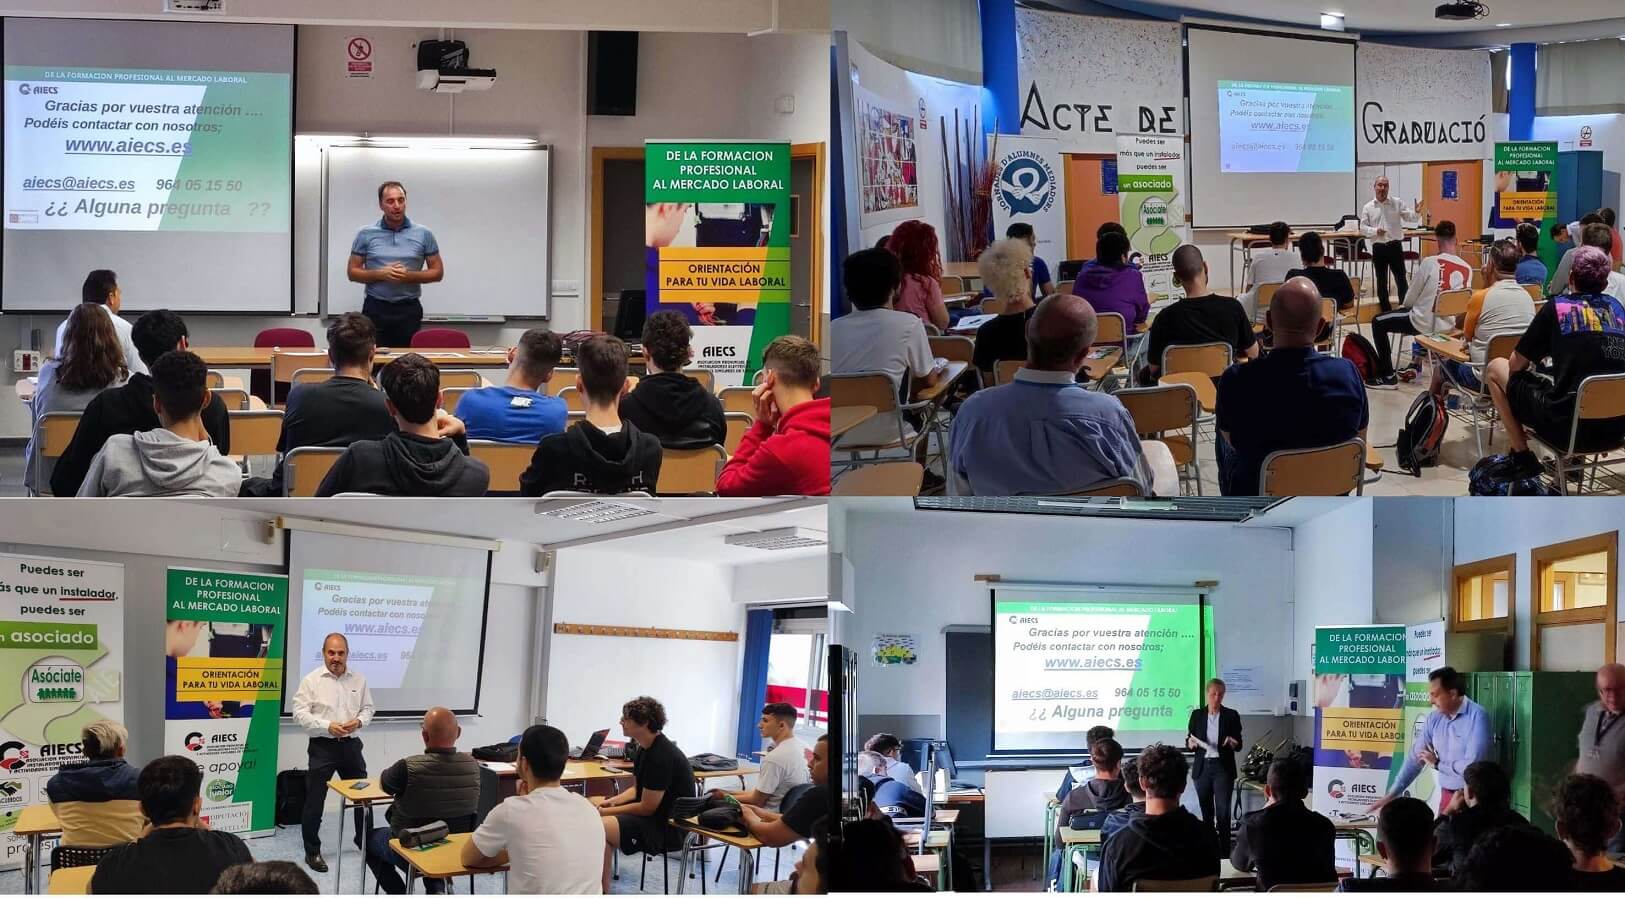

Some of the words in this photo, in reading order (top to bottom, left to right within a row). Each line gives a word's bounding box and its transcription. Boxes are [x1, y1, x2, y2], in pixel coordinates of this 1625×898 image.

[56, 71, 66, 79] LA
[67, 72, 112, 80] FORMACION
[114, 73, 164, 81] PROFESIONAL
[33, 86, 58, 95] AIECS
[45, 100, 98, 112] Gracias
[101, 103, 125, 115] por
[129, 103, 180, 115] vuestra
[183, 104, 241, 116] atención
[24, 117, 69, 129] Podéis
[72, 119, 132, 130] contactar
[135, 121, 159, 131] con
[162, 122, 223, 135] nosotros;
[65, 137, 193, 155] www.aiecs.es
[666, 151, 680, 160] DE
[684, 151, 698, 160] LA
[701, 151, 773, 161] FORMACION
[680, 165, 757, 175] PROFESIONAL
[23, 175, 135, 192] aiecs@aiecs.es
[156, 179, 181, 190] 964
[185, 179, 202, 191] 05
[205, 179, 222, 191] 15
[225, 180, 243, 192] 50
[653, 179, 667, 189] AL
[670, 179, 729, 190] MERCADO
[732, 179, 784, 190] LABORAL
[1132, 179, 1172, 189] asociado
[74, 198, 142, 218] Alguna
[147, 202, 232, 219] pregunta
[248, 202, 271, 217] ??
[1148, 254, 1169, 262] AIECS
[688, 262, 760, 274] ORIENTACIÓN
[666, 277, 693, 287] PARA
[697, 277, 708, 287] TU
[711, 277, 737, 287] VIDA
[740, 277, 786, 287] LABORAL
[702, 346, 736, 358] AIECS
[20, 563, 64, 576] Puedes
[67, 569, 85, 577] ser
[185, 577, 198, 586] DE
[200, 578, 213, 587] LA
[215, 579, 275, 591] FORMACION
[14, 585, 39, 597] que
[42, 586, 57, 595] un
[60, 587, 119, 600] instalador,
[197, 590, 261, 602] PROFESIONAL
[331, 594, 367, 604] Gracias
[368, 597, 385, 606] por
[386, 597, 418, 607] vuestra
[20, 605, 65, 616] puedes
[68, 607, 85, 616] ser
[173, 601, 186, 609] AL
[187, 602, 238, 612] MERCADO
[240, 604, 281, 614] LABORAL
[318, 607, 348, 617] Podéis
[349, 608, 387, 618] contactar
[389, 610, 405, 619] con
[10, 630, 94, 644] asociado
[1028, 628, 1070, 638] Gracias
[1072, 630, 1090, 639] por
[1093, 629, 1131, 638] vuestra
[1134, 629, 1178, 639] atención
[1013, 641, 1047, 651] Podéis
[1049, 642, 1095, 651] contactar
[1097, 643, 1116, 651] con
[1118, 643, 1165, 653] nosotros;
[1339, 644, 1396, 653] PROFESIONAL
[1044, 655, 1143, 671] www.aiecs.es
[1319, 656, 1330, 664] AL
[1331, 656, 1375, 664] MERCADO
[31, 667, 82, 683] Asóciate
[202, 669, 260, 679] ORIENTACIÓN
[1011, 688, 1098, 700] aiecs@aiecs.es
[1114, 687, 1133, 697] 964
[1136, 688, 1150, 697] 05
[1152, 688, 1165, 697] 15
[1167, 688, 1181, 698] 50
[1052, 704, 1104, 720] Alguna
[1108, 705, 1174, 721] pregunta
[1342, 719, 1396, 729] ORIENTACIÓN
[211, 733, 238, 743] AIECS
[1326, 729, 1347, 738] PARA
[1348, 730, 1357, 738] TU
[1359, 730, 1377, 738] VIDA
[40, 743, 82, 757] AIECS
[1351, 783, 1377, 793] AIECS
